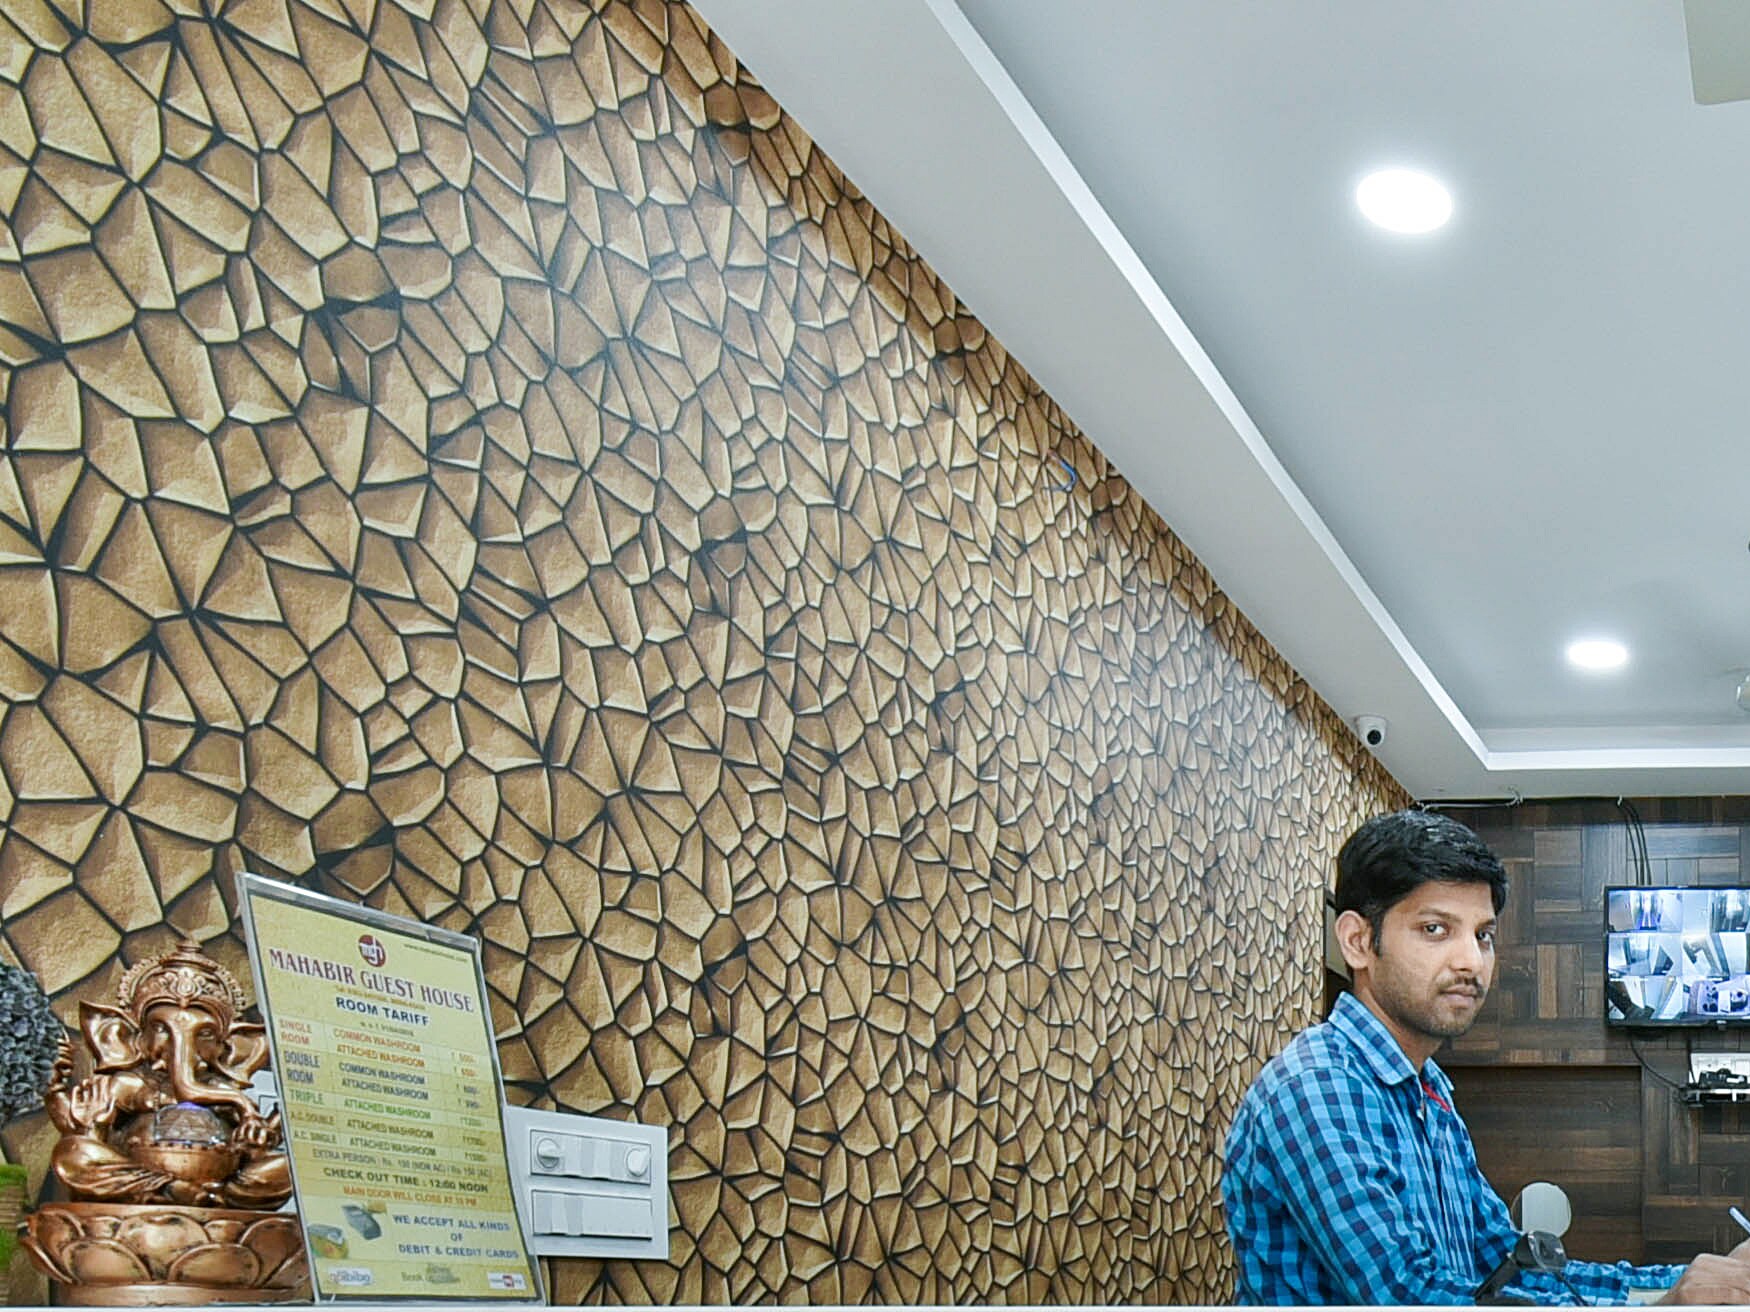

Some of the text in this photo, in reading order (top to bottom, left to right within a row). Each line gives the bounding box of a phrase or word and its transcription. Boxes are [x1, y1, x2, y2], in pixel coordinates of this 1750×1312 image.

[269, 948, 356, 986] MAHABIR
[360, 970, 415, 999] GUEST
[420, 984, 474, 1013] HOUSE
[336, 996, 379, 1015] ROOM
[382, 1007, 429, 1026] TARIFF
[280, 1031, 310, 1045] ROOM
[333, 1028, 373, 1044] COMMON
[374, 1034, 421, 1053] WASHROOM
[283, 1049, 320, 1068] DOUBLE
[336, 1043, 425, 1067] ATTACHED WASHROOM
[286, 1067, 314, 1084] ROOM
[338, 1061, 425, 1085] COMMON WASHROOM
[289, 1089, 324, 1105] TRIPLE
[341, 1078, 429, 1100] ATTACHED WASHROOM
[343, 1098, 431, 1120] ATTACHED WASHROOM
[346, 1119, 434, 1139] ATTACHED WASHROOM
[349, 1137, 437, 1157] ATTACHED WASHROOM
[323, 1167, 363, 1181] CHECK
[366, 1171, 389, 1183] OUT
[394, 1175, 419, 1187] TIME
[459, 1181, 488, 1193] NOON
[343, 1186, 366, 1196] MAIN
[367, 1188, 391, 1199] DOOR
[391, 1189, 412, 1201] WILL
[414, 1192, 441, 1204] CLOSE
[444, 1195, 454, 1205] AT
[393, 1215, 510, 1231] WE ACCEPT ALL KINDS
[450, 1231, 463, 1242] OF
[398, 1244, 519, 1260] DEBIT & CREDIT CARDS
